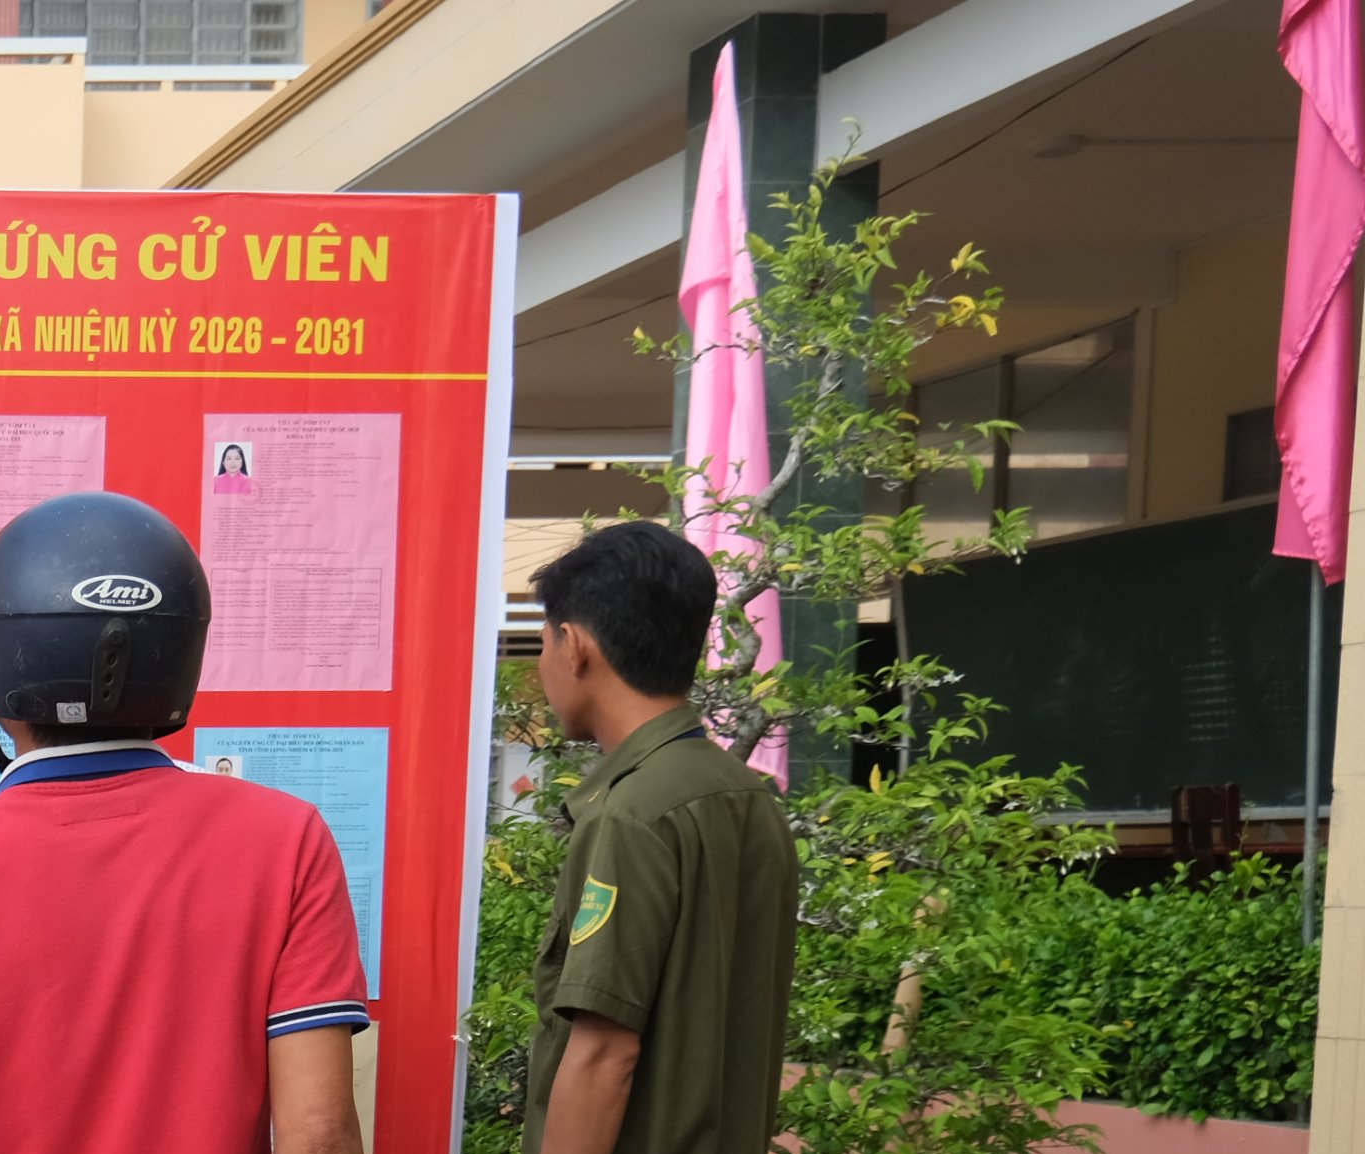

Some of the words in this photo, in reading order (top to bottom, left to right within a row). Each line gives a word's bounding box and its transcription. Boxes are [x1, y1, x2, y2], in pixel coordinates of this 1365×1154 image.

[138, 216, 228, 282] CỬ
[245, 223, 391, 283] VIÊN
[35, 309, 131, 362] NHIỆM
[140, 308, 179, 354] KỲ
[189, 317, 264, 356] 2026
[296, 318, 366, 357] 2031
